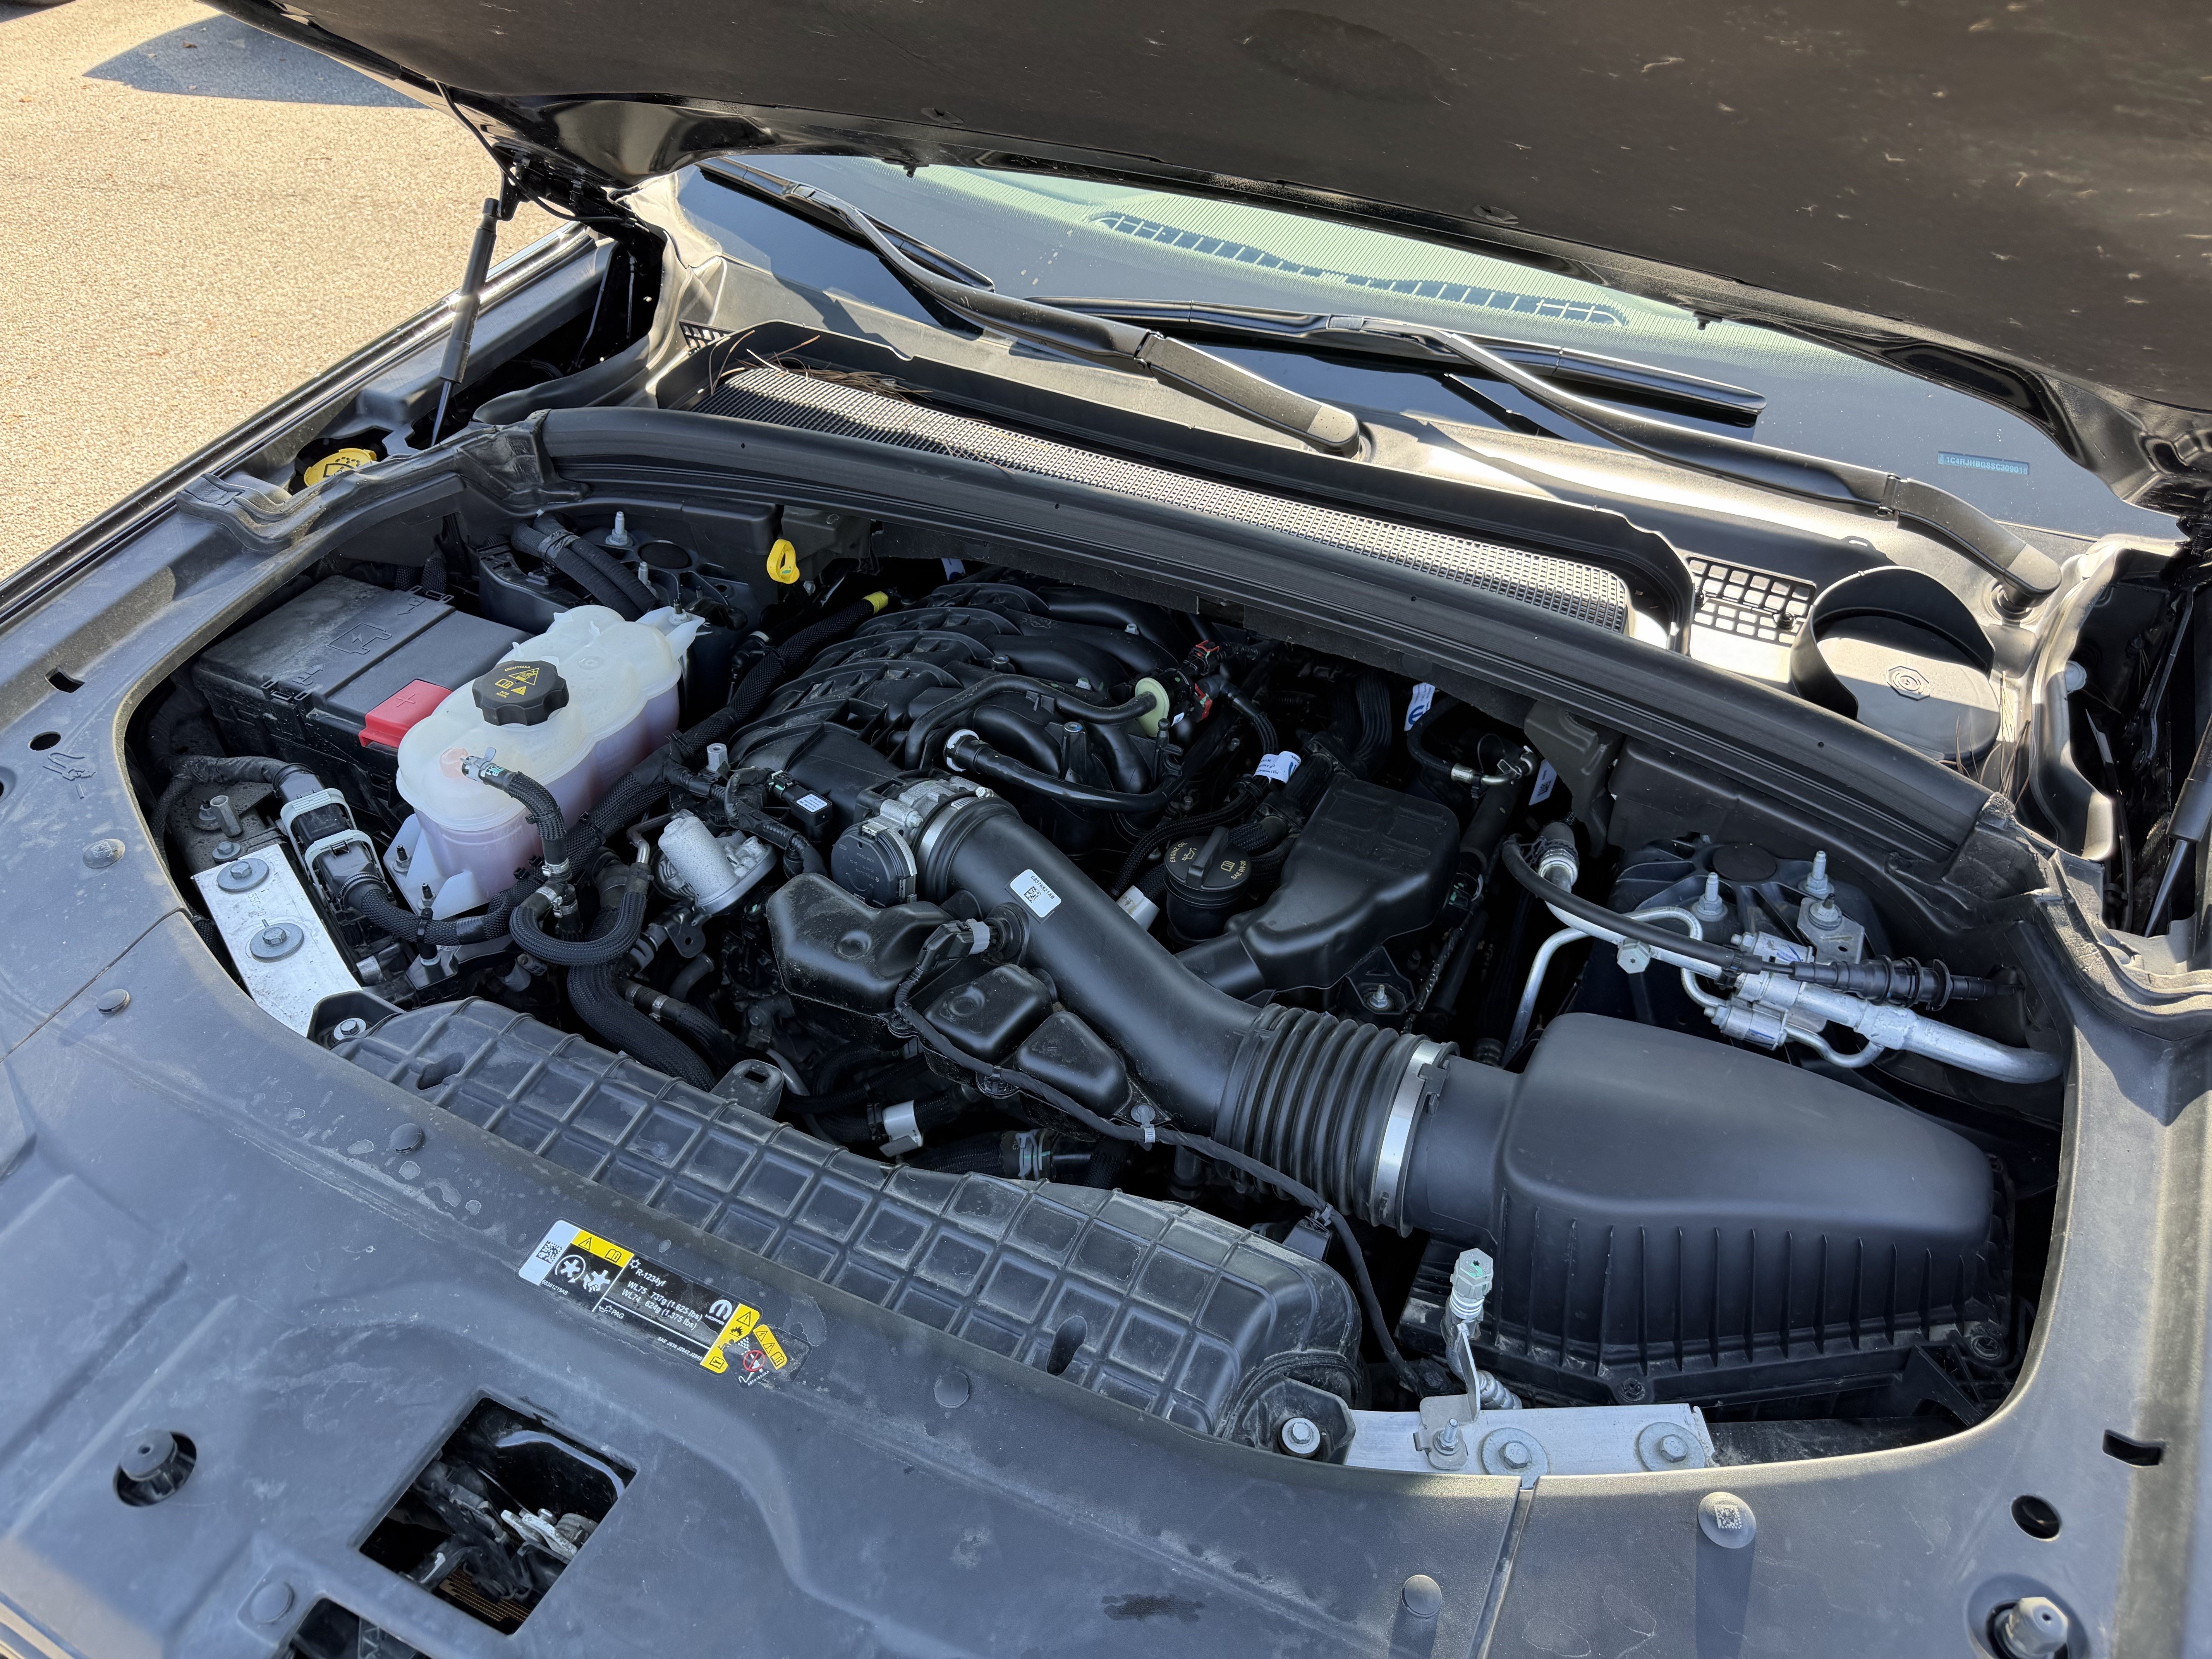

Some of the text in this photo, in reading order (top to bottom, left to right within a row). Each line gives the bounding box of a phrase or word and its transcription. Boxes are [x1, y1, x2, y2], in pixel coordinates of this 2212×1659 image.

[1170, 847, 1180, 862] ENGINE
[1231, 871, 1242, 879] SAE
[635, 1269, 666, 1286] R-1234yf
[622, 1289, 697, 1330] WL74 624g (1.375 lbs)
[627, 1281, 702, 1322] WL75 737g (1.625 lbs)
[611, 1309, 625, 1319] PAG
